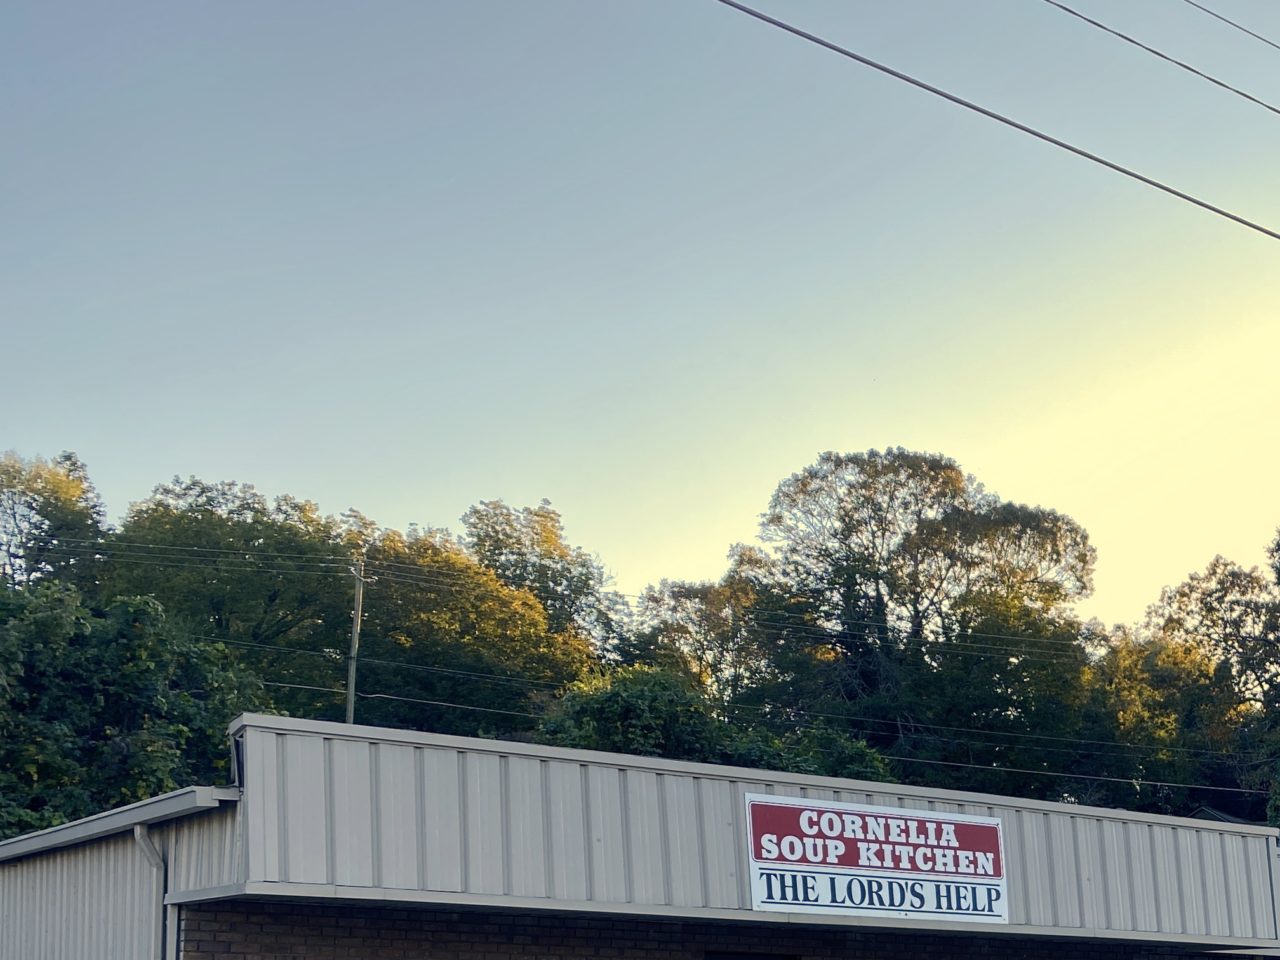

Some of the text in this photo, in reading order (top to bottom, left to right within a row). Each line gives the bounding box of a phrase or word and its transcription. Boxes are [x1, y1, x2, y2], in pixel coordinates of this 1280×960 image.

[799, 810, 960, 848] CORNELIA
[760, 833, 995, 876] SOUP KITCHEN
[759, 872, 1001, 914] THE LORD'S HELP
